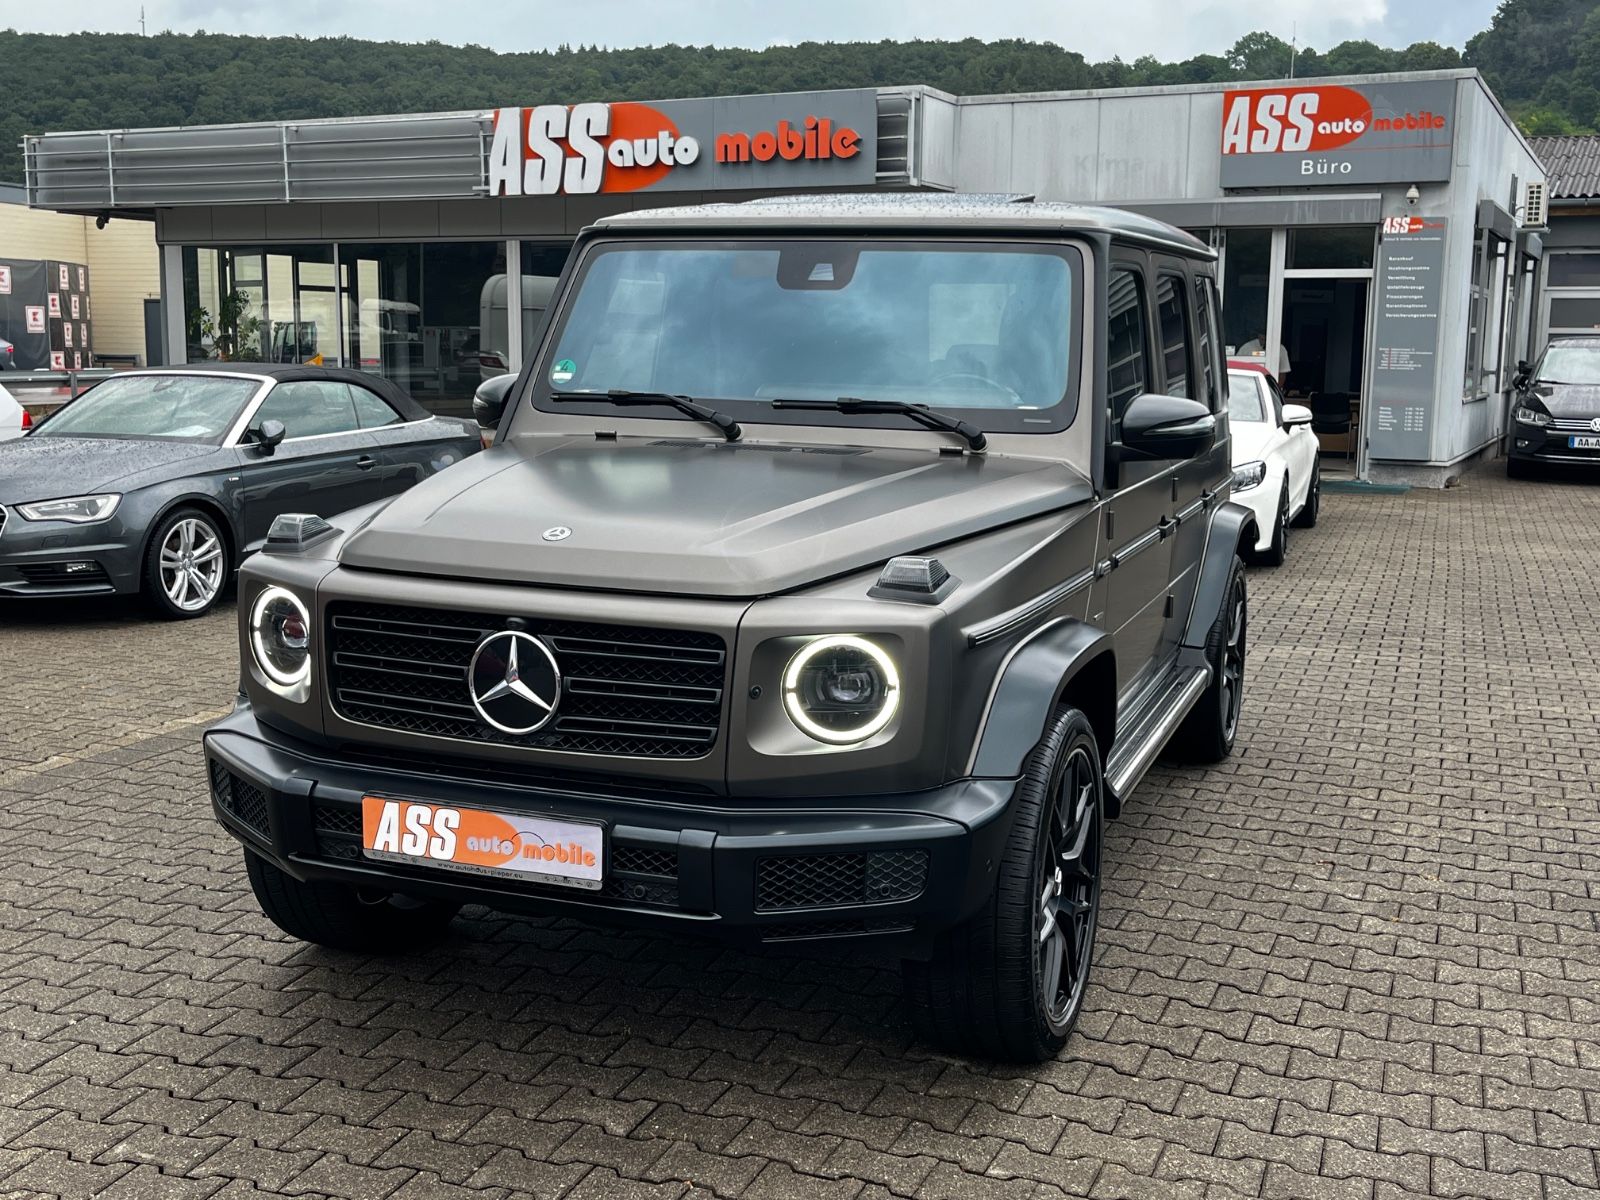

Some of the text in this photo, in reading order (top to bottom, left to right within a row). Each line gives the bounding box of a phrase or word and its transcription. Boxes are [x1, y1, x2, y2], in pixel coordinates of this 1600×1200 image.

[489, 102, 863, 196] ASS auto mobile
[1223, 93, 1446, 154] ASS auto mobile
[1301, 159, 1352, 175] Büro
[1383, 217, 1410, 234] ASS
[372, 800, 596, 867] ASS auto mobile
